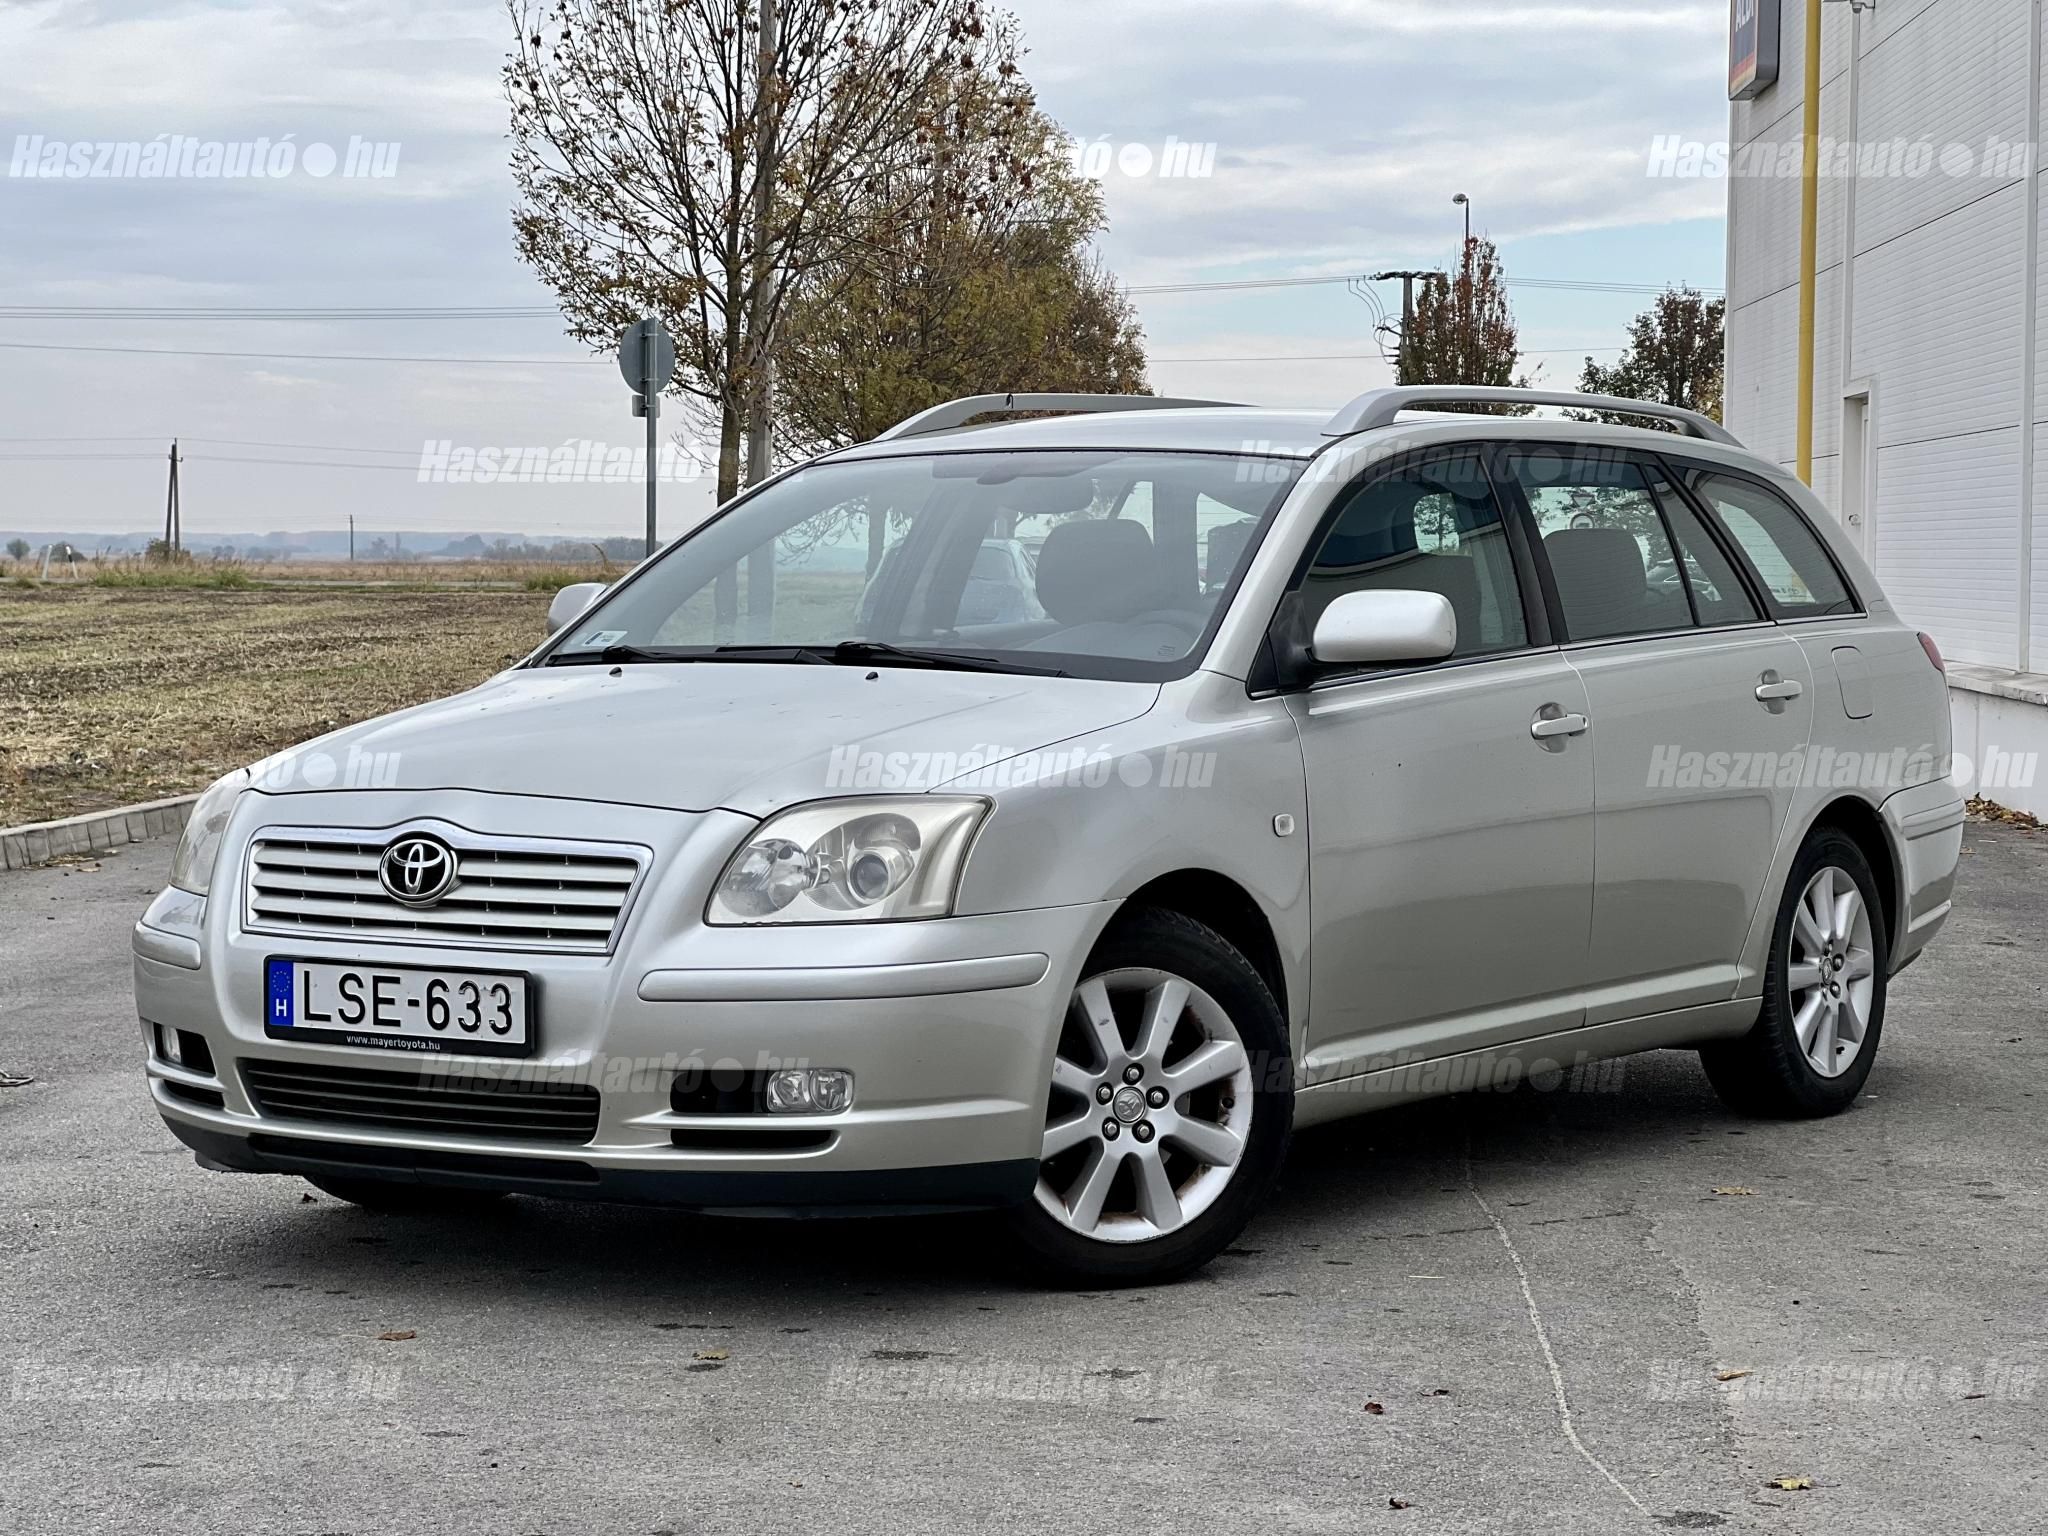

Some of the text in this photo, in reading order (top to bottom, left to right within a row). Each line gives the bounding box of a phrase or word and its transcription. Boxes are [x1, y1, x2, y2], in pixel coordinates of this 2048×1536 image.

[275, 998, 288, 1018] H
[303, 970, 513, 1036] LSE-633
[346, 1035, 441, 1050] www.mayertoyota.hu
